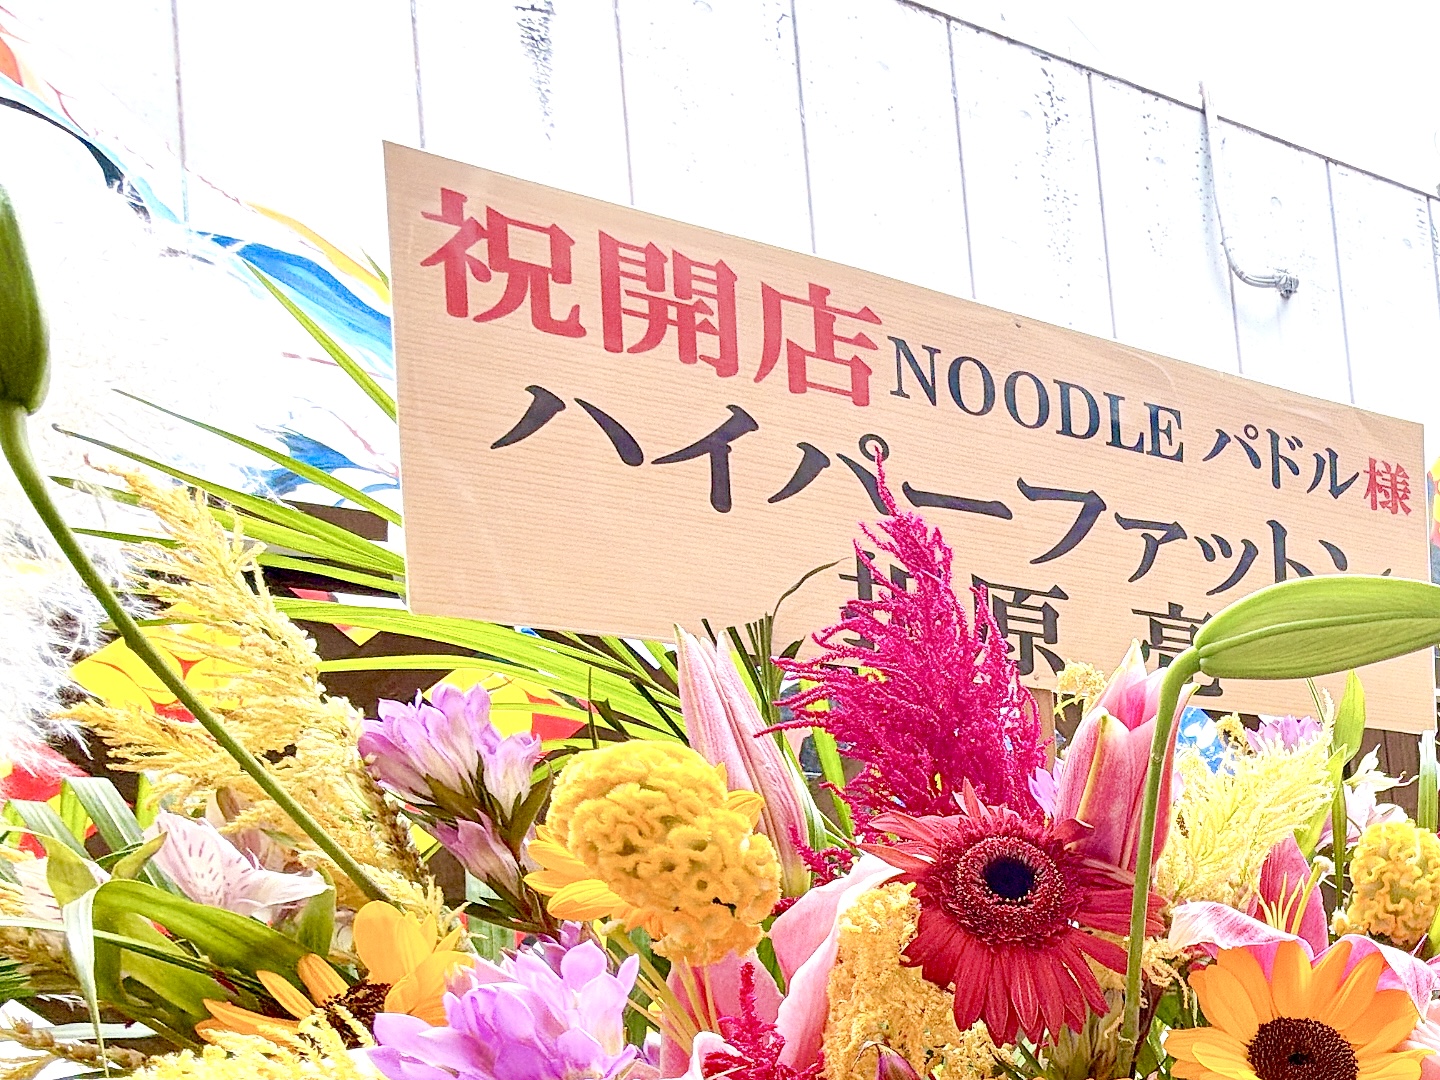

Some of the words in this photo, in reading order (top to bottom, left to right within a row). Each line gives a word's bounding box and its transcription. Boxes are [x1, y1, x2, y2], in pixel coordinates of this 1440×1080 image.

[421, 187, 883, 407] 祝開店
[887, 335, 1185, 463] NOODLE
